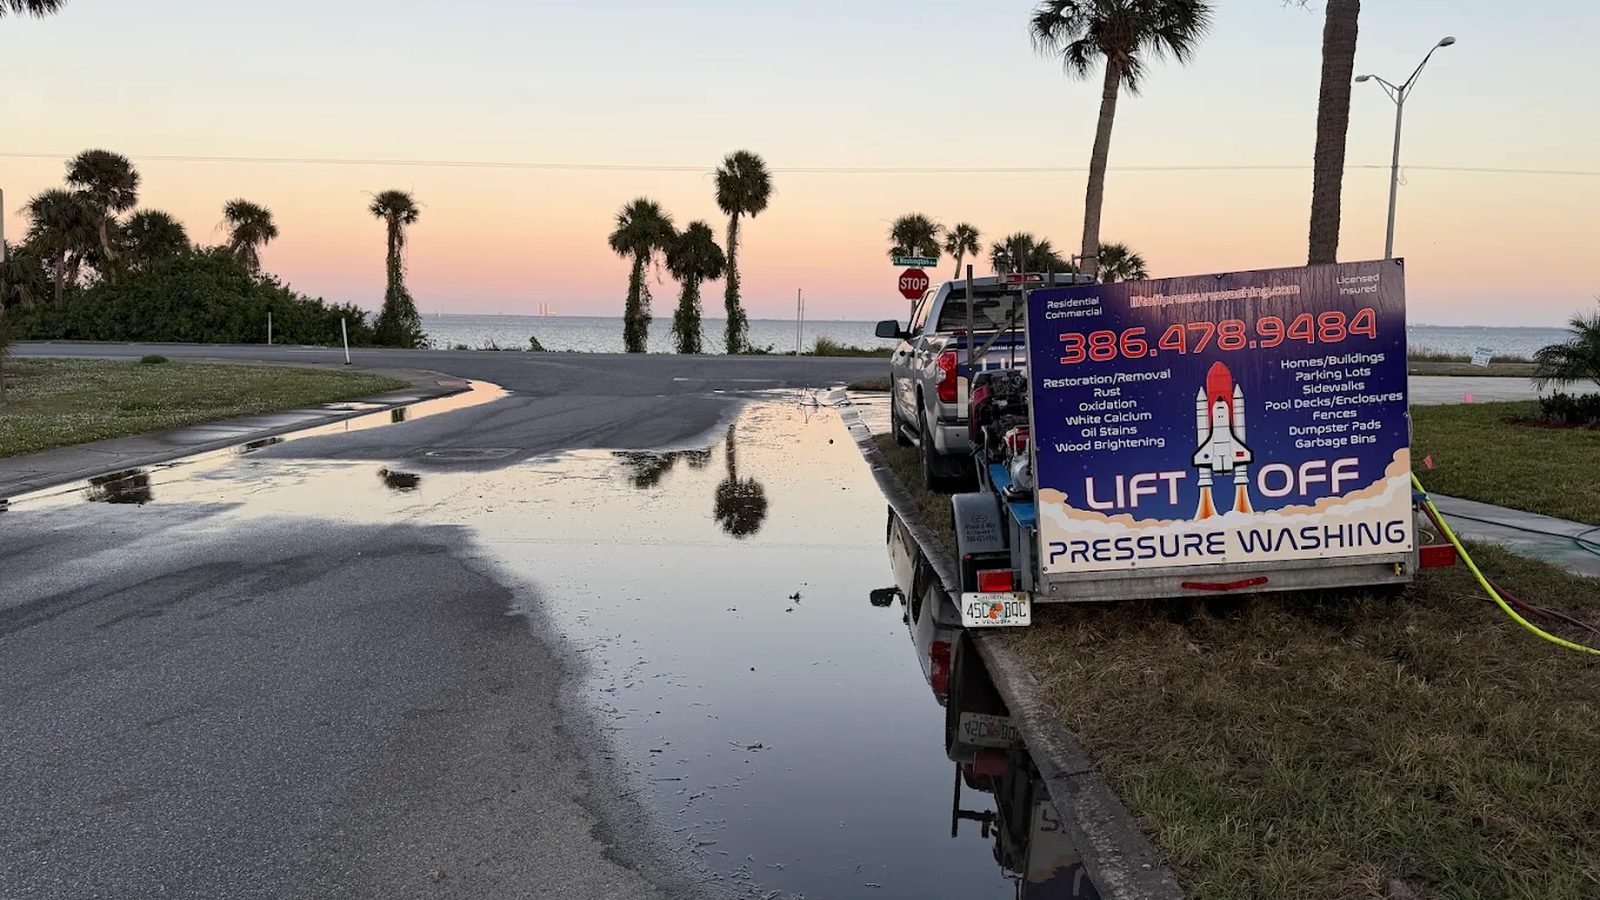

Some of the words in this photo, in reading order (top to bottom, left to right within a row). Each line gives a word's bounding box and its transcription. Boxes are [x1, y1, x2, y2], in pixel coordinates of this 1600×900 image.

[900, 257, 929, 267] Washington
[900, 277, 928, 290] STOP
[1336, 273, 1380, 285] Licensed
[1130, 284, 1300, 308] liftoffpressurewashing.com
[1339, 284, 1377, 295] Insured
[1047, 296, 1100, 309] Residential
[1045, 307, 1102, 320] Commercial
[1059, 307, 1377, 364] 386.478.9484
[1281, 353, 1385, 369] Homes/Buildings
[1043, 368, 1171, 389] Restoration/Removal
[1296, 369, 1342, 381] Parking
[1345, 367, 1371, 377] Lots
[1094, 387, 1121, 397] Rust
[1302, 380, 1365, 394] Sidewalks
[1079, 399, 1137, 411] Oxidation
[1265, 399, 1291, 411] Pool
[1294, 392, 1403, 408] Decks/Enclosures
[1065, 414, 1101, 426] White
[1104, 411, 1152, 423] Calcium
[1313, 409, 1357, 420] Fences
[1081, 427, 1097, 438] Oil
[1100, 425, 1138, 436] Stains
[1289, 423, 1349, 436] Dumpster
[1352, 419, 1381, 431] Pads
[1055, 441, 1091, 453] Wood
[1094, 437, 1165, 451] Brightening
[1295, 437, 1348, 449] Garbage
[1350, 434, 1377, 444] Bins
[1085, 470, 1187, 510] LIFT
[1257, 457, 1360, 498] OFF
[1049, 531, 1226, 565] PRESSURE
[1236, 520, 1406, 553] WASHING
[966, 602, 989, 619] 45C
